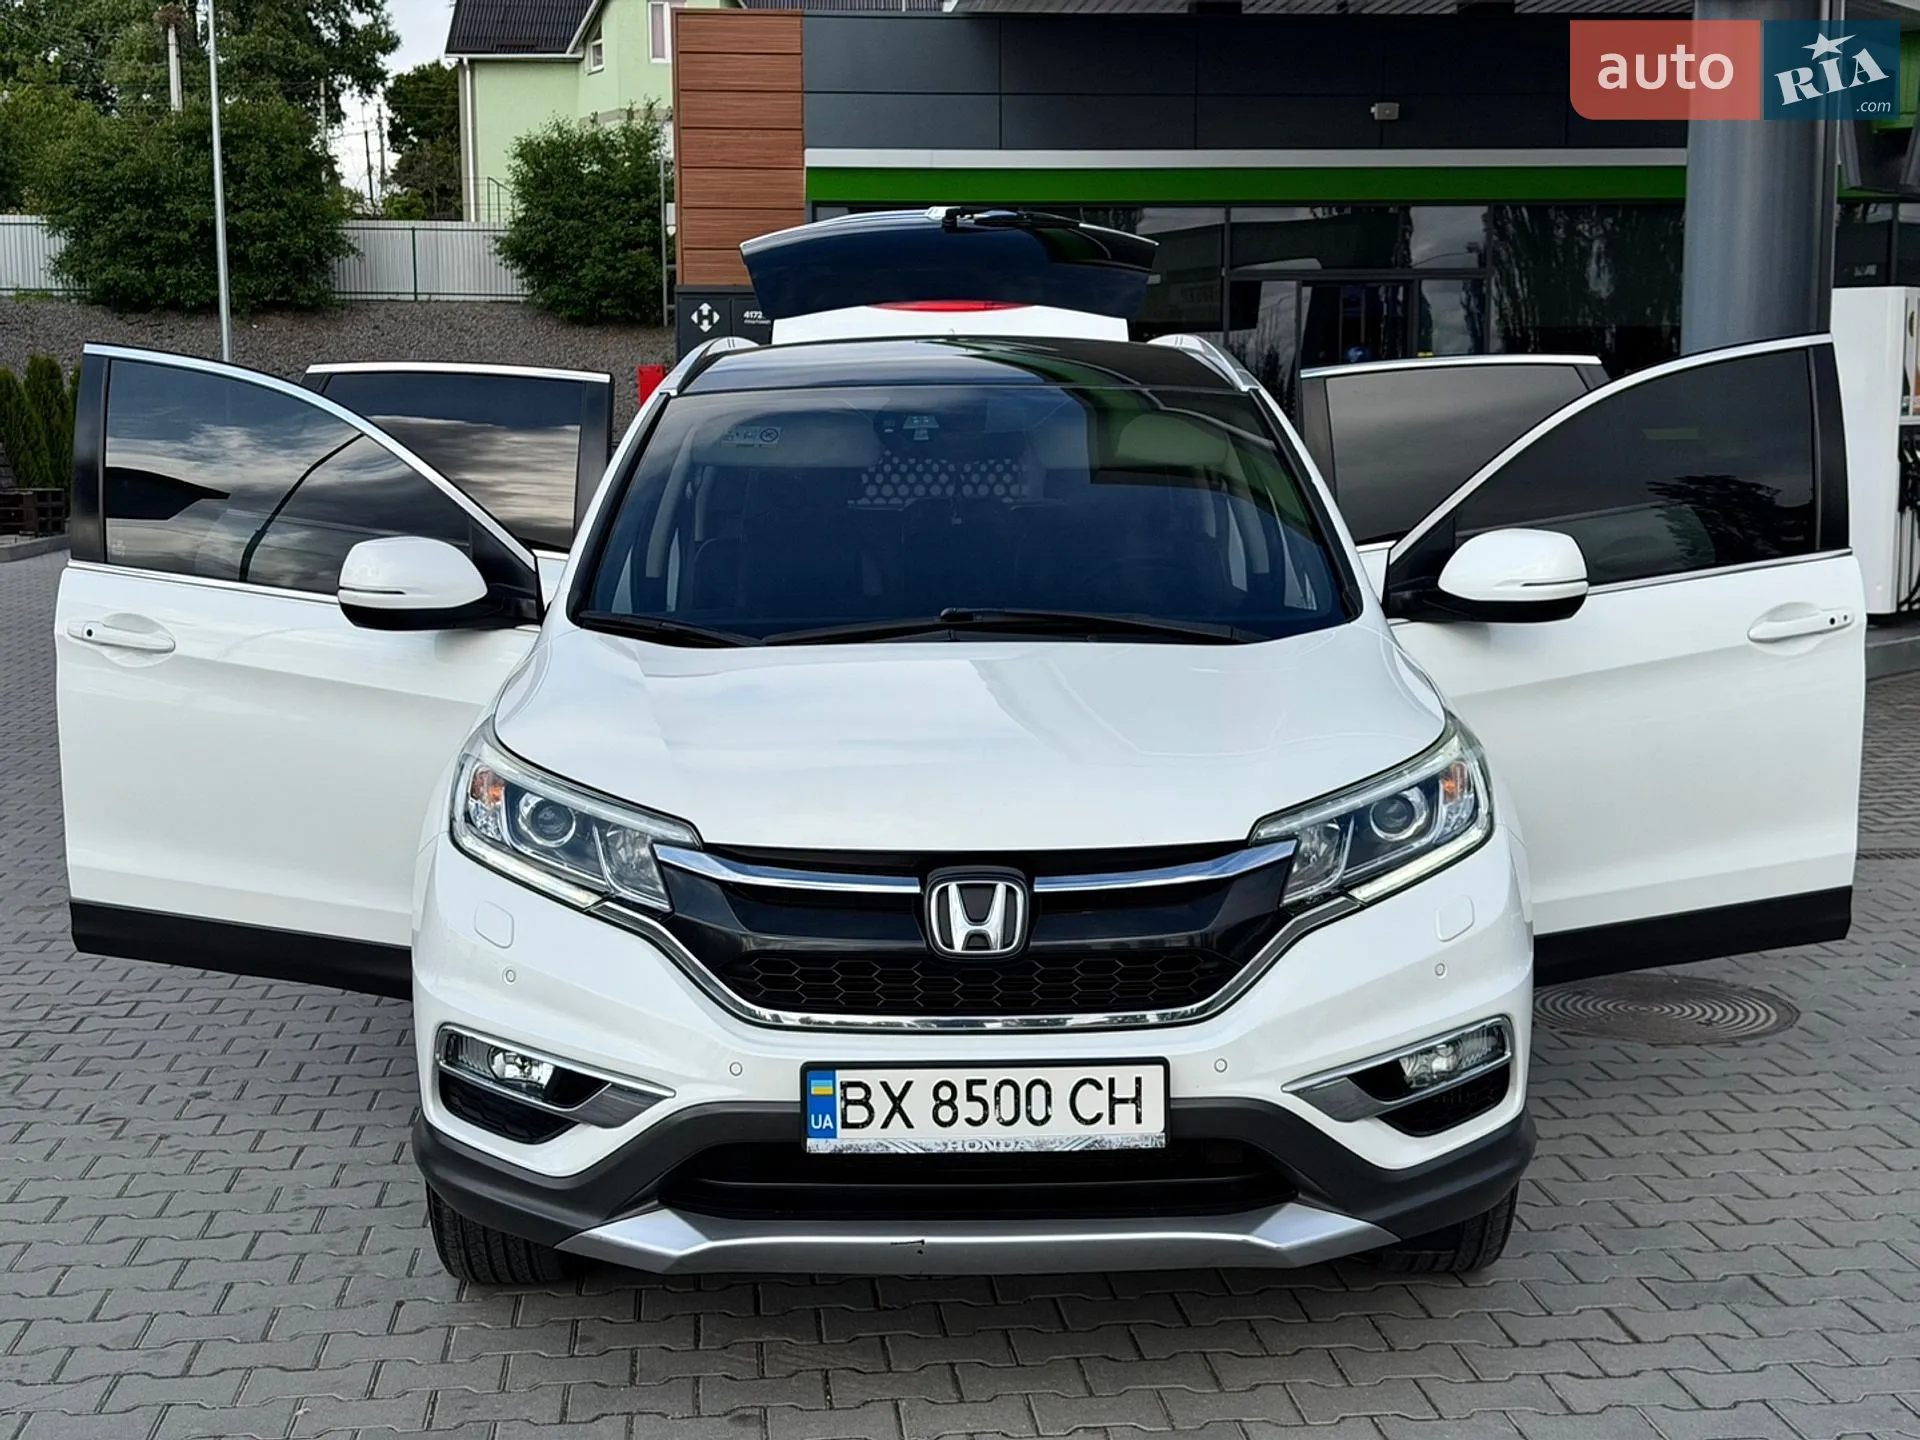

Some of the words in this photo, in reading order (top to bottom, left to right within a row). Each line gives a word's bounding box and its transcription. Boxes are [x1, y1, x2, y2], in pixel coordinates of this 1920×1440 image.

[839, 1080, 915, 1130] BX
[931, 1078, 1053, 1128] 8500
[1069, 1076, 1143, 1126] CH
[811, 1114, 834, 1130] UA
